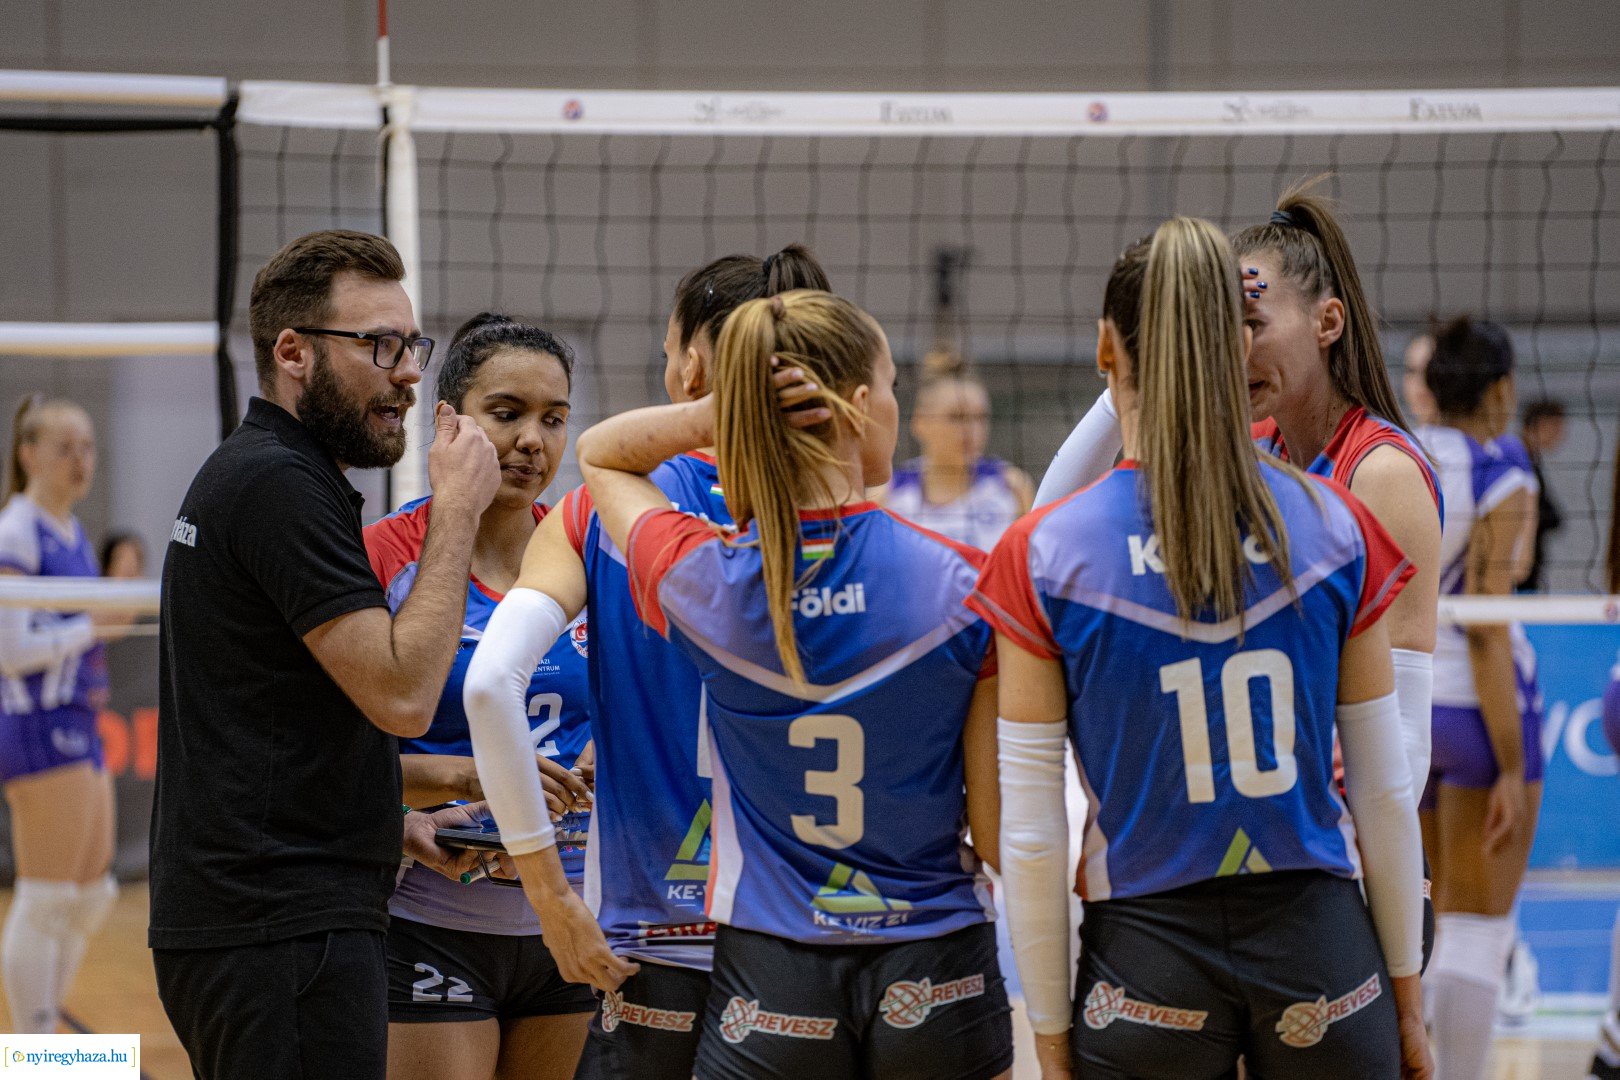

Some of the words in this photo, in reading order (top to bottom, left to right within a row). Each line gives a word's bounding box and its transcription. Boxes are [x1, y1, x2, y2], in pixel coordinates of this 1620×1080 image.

[1159, 648, 1298, 803] 10
[788, 714, 864, 850] 3
[412, 962, 473, 1002] 22
[620, 1003, 695, 1031] REVESZ
[752, 1012, 834, 1037] REVESZ
[1119, 1000, 1205, 1028] REVESZ
